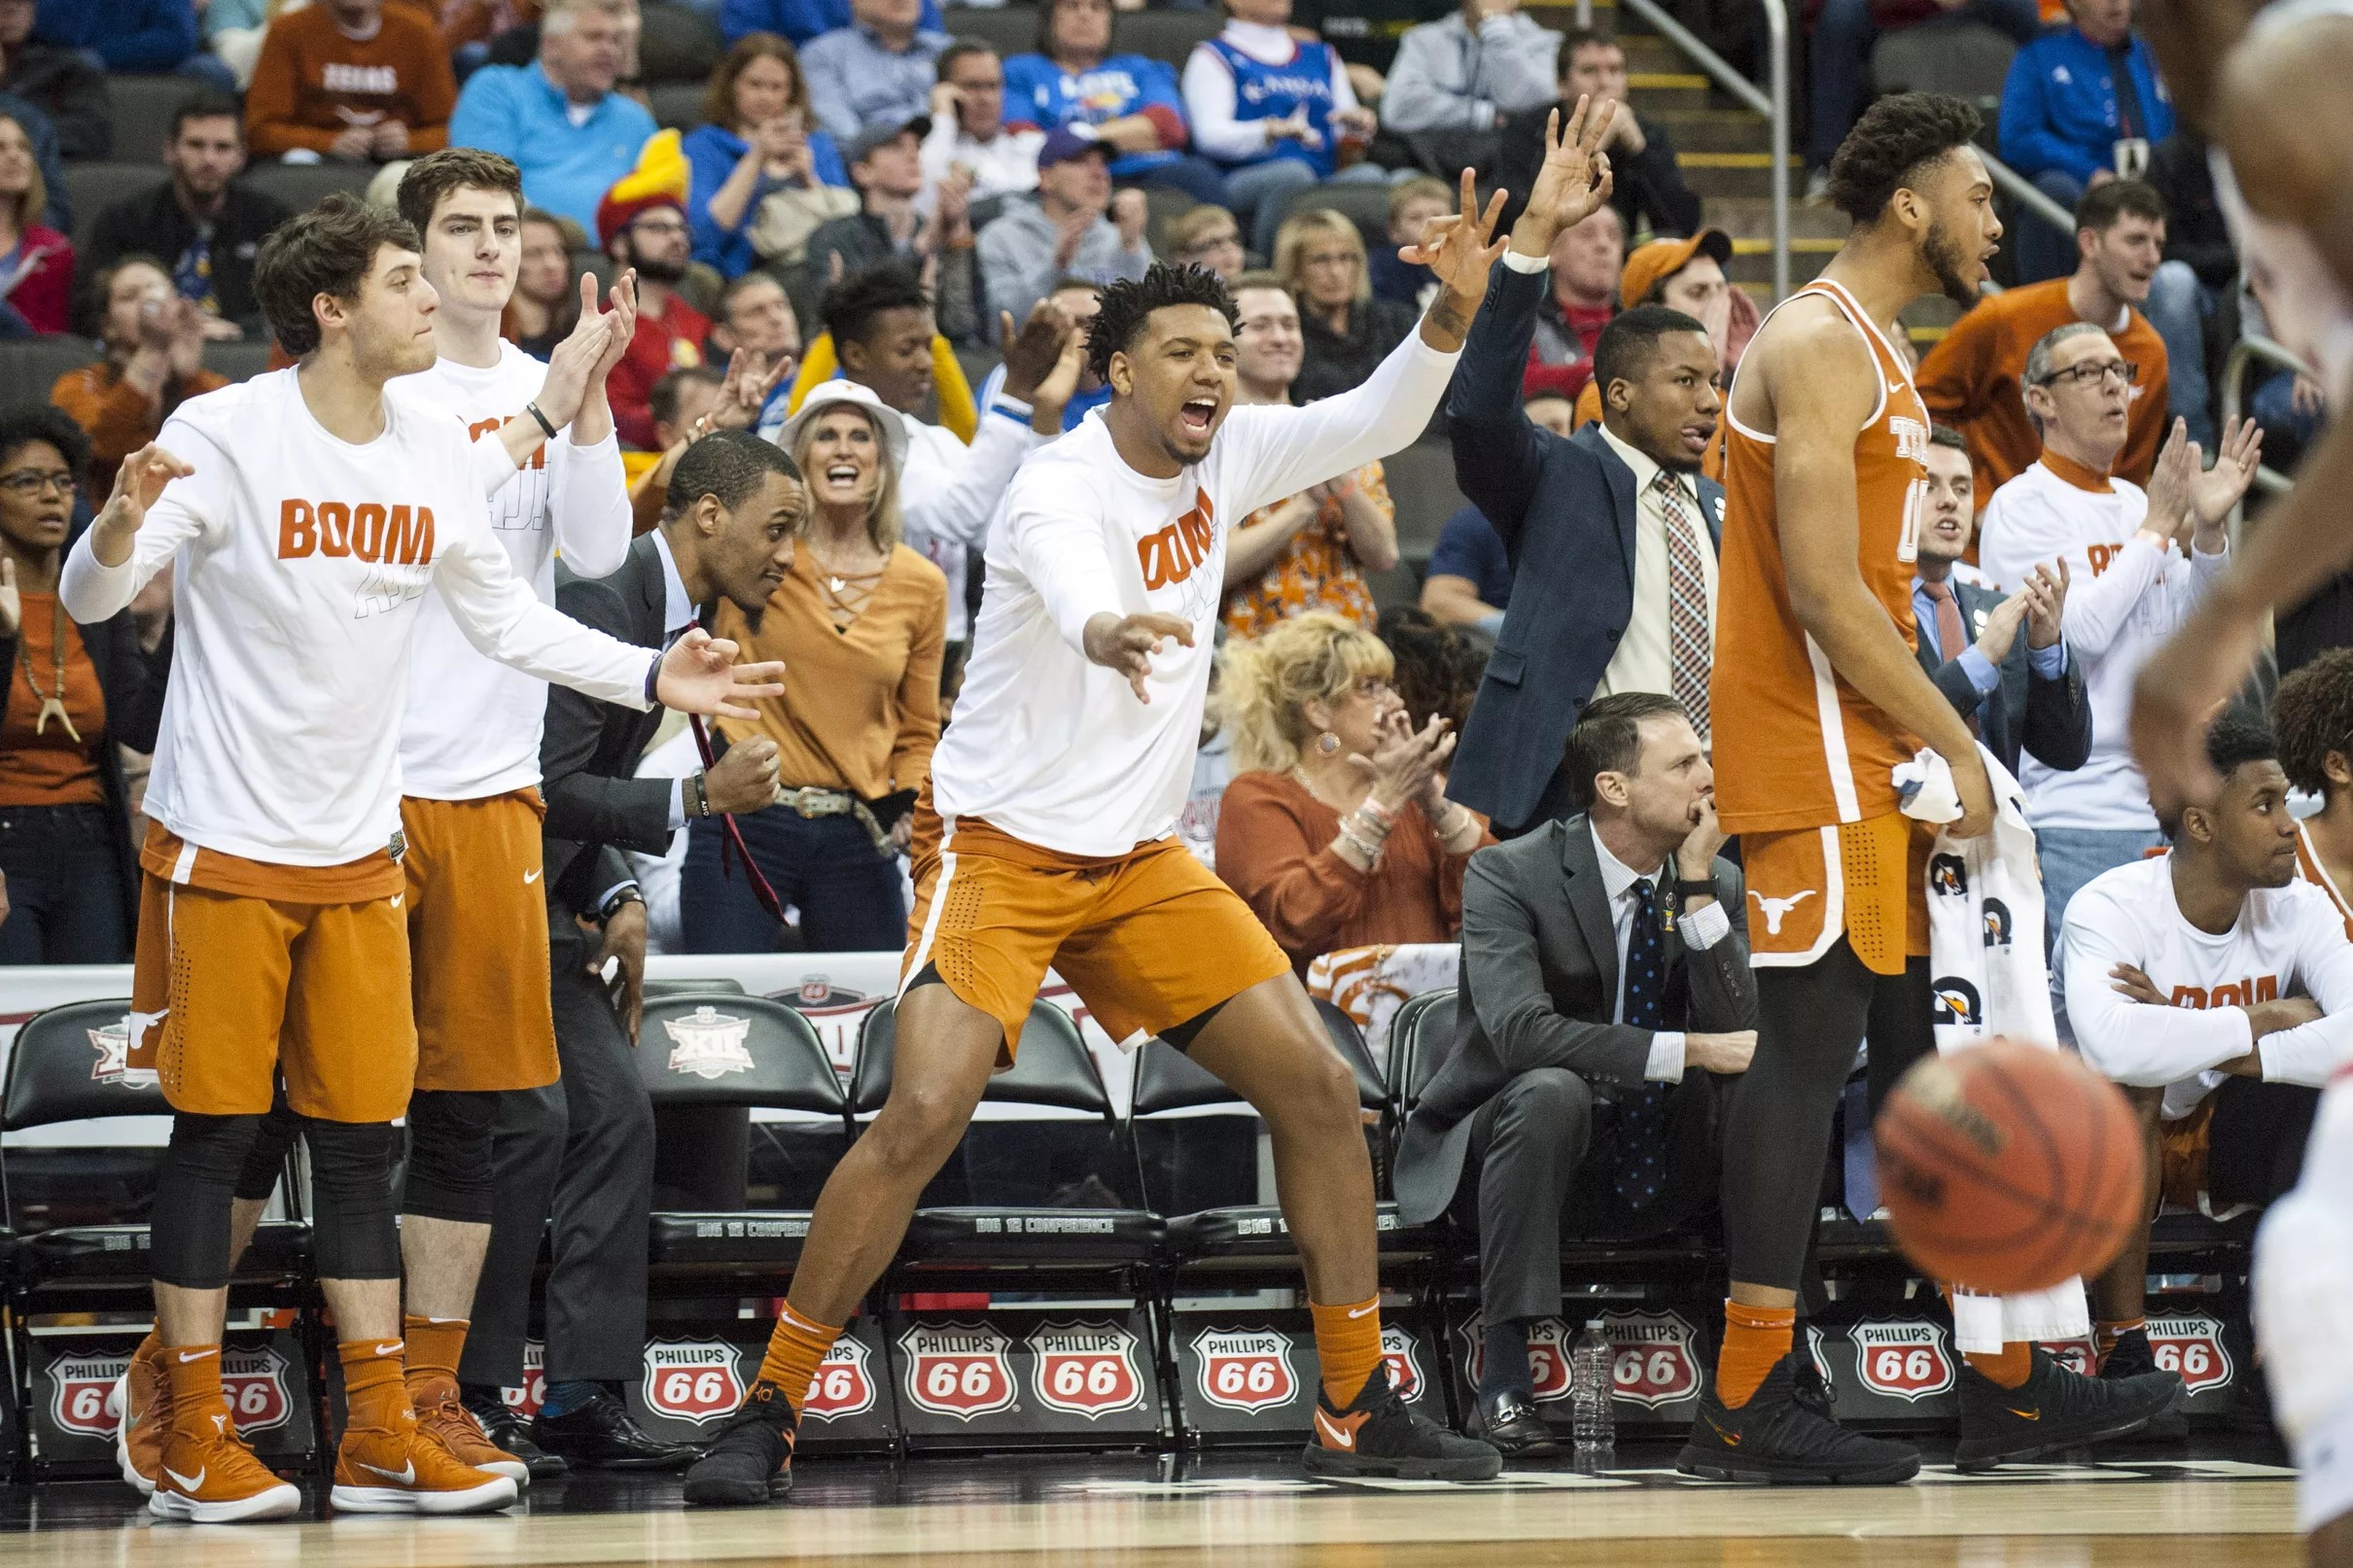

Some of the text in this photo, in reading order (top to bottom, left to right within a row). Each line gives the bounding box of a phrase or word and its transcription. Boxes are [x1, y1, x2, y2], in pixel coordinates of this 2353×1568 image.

[278, 498, 435, 565] BOOM
[694, 1222, 811, 1237] BIG 12 CONFERE
[976, 1218, 1114, 1234] BIG 12 CONFERENCE
[1238, 1217, 1290, 1235] BIG 1
[104, 1236, 131, 1251] BIG
[1603, 1324, 1680, 1341] PHILLIPS
[1865, 1328, 1933, 1342] PHILLIPS
[917, 1337, 995, 1353] PHILLIPS
[1044, 1335, 1120, 1351] PHILLIPS
[1209, 1339, 1276, 1354] PHILLIPS
[655, 1349, 724, 1364] PHILLIPS
[2155, 1343, 2210, 1375] 66
[64, 1363, 130, 1379] PHILLIP
[222, 1359, 272, 1374] ILLIPS
[1528, 1350, 1552, 1384] 6
[1613, 1350, 1677, 1385] 66
[1876, 1350, 1932, 1381] 66
[928, 1362, 992, 1397] 66
[1054, 1360, 1119, 1395] 66
[1217, 1361, 1276, 1393] 66
[663, 1373, 723, 1404] 66
